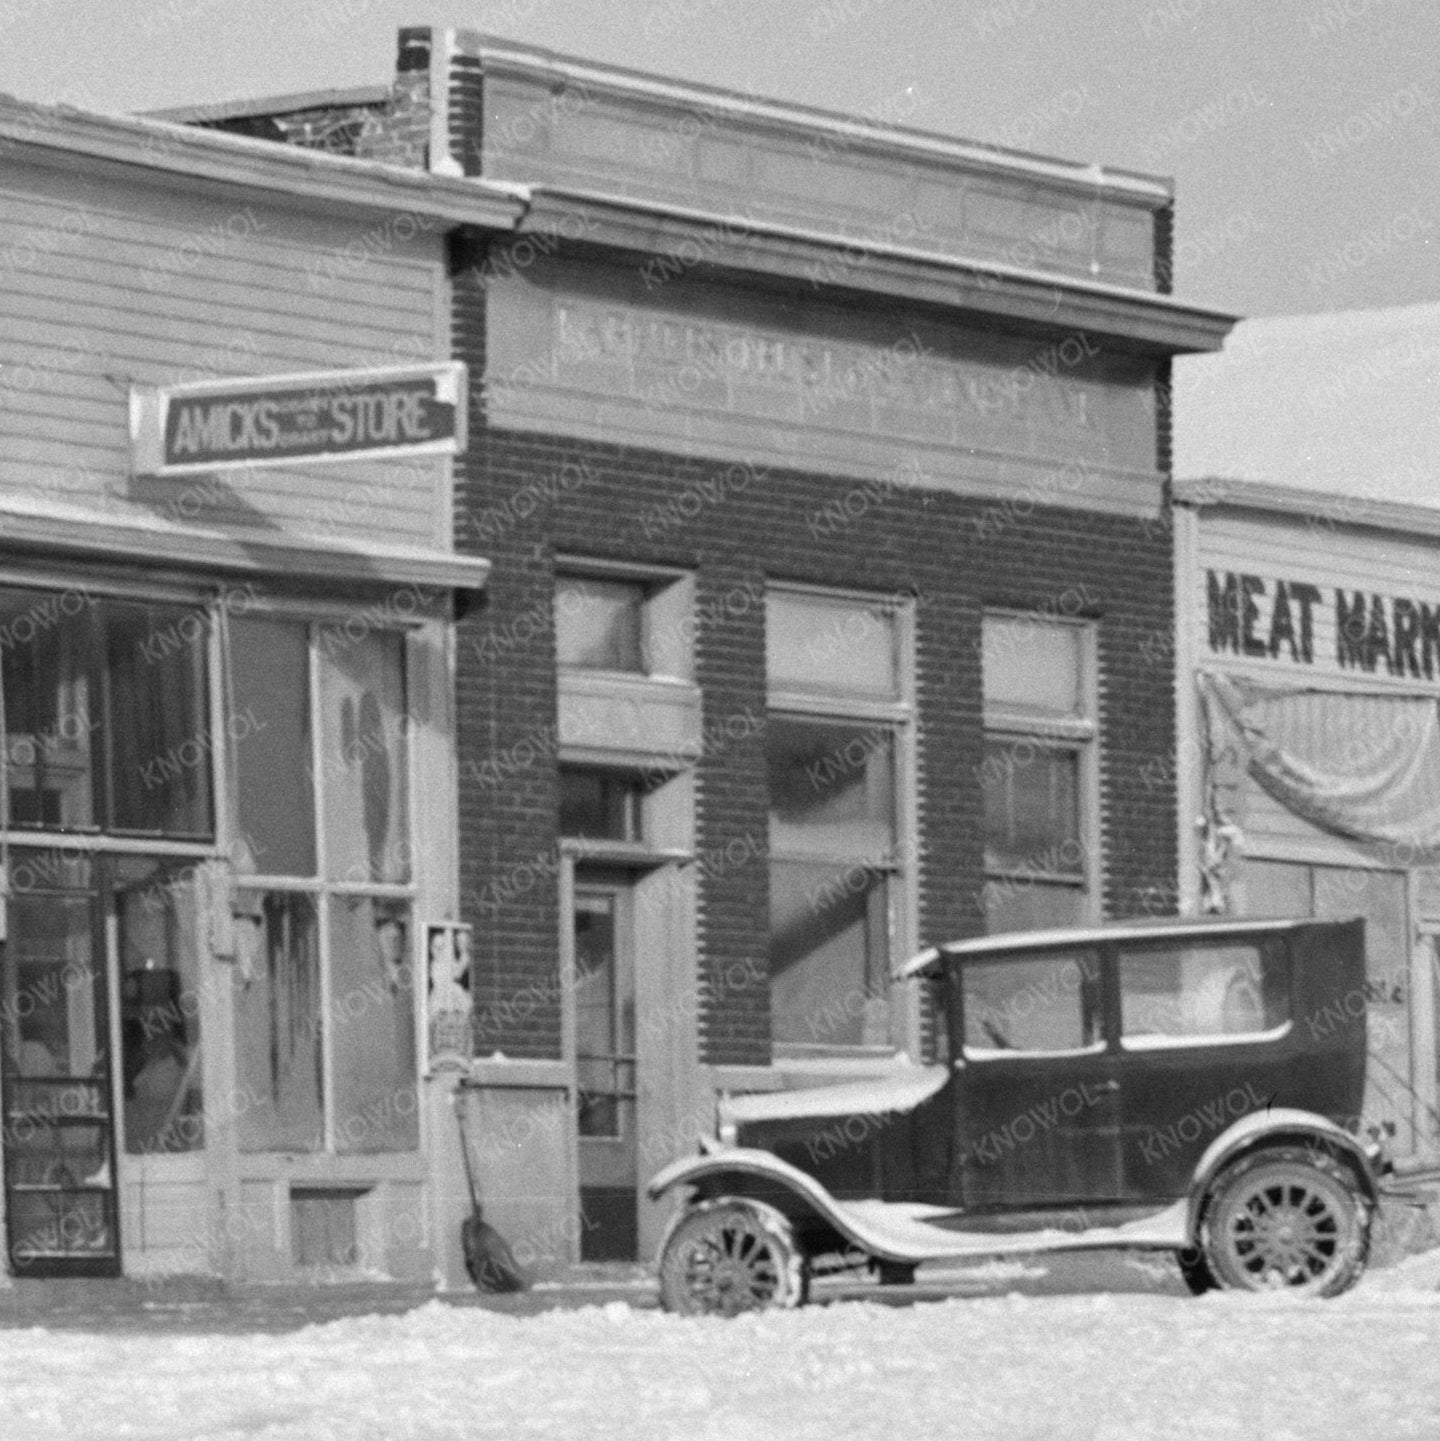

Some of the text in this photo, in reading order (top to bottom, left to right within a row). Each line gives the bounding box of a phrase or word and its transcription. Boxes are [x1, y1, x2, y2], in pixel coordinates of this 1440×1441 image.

[172, 391, 431, 454] AMICKS STORE
[1205, 568, 1322, 664] MEAT
